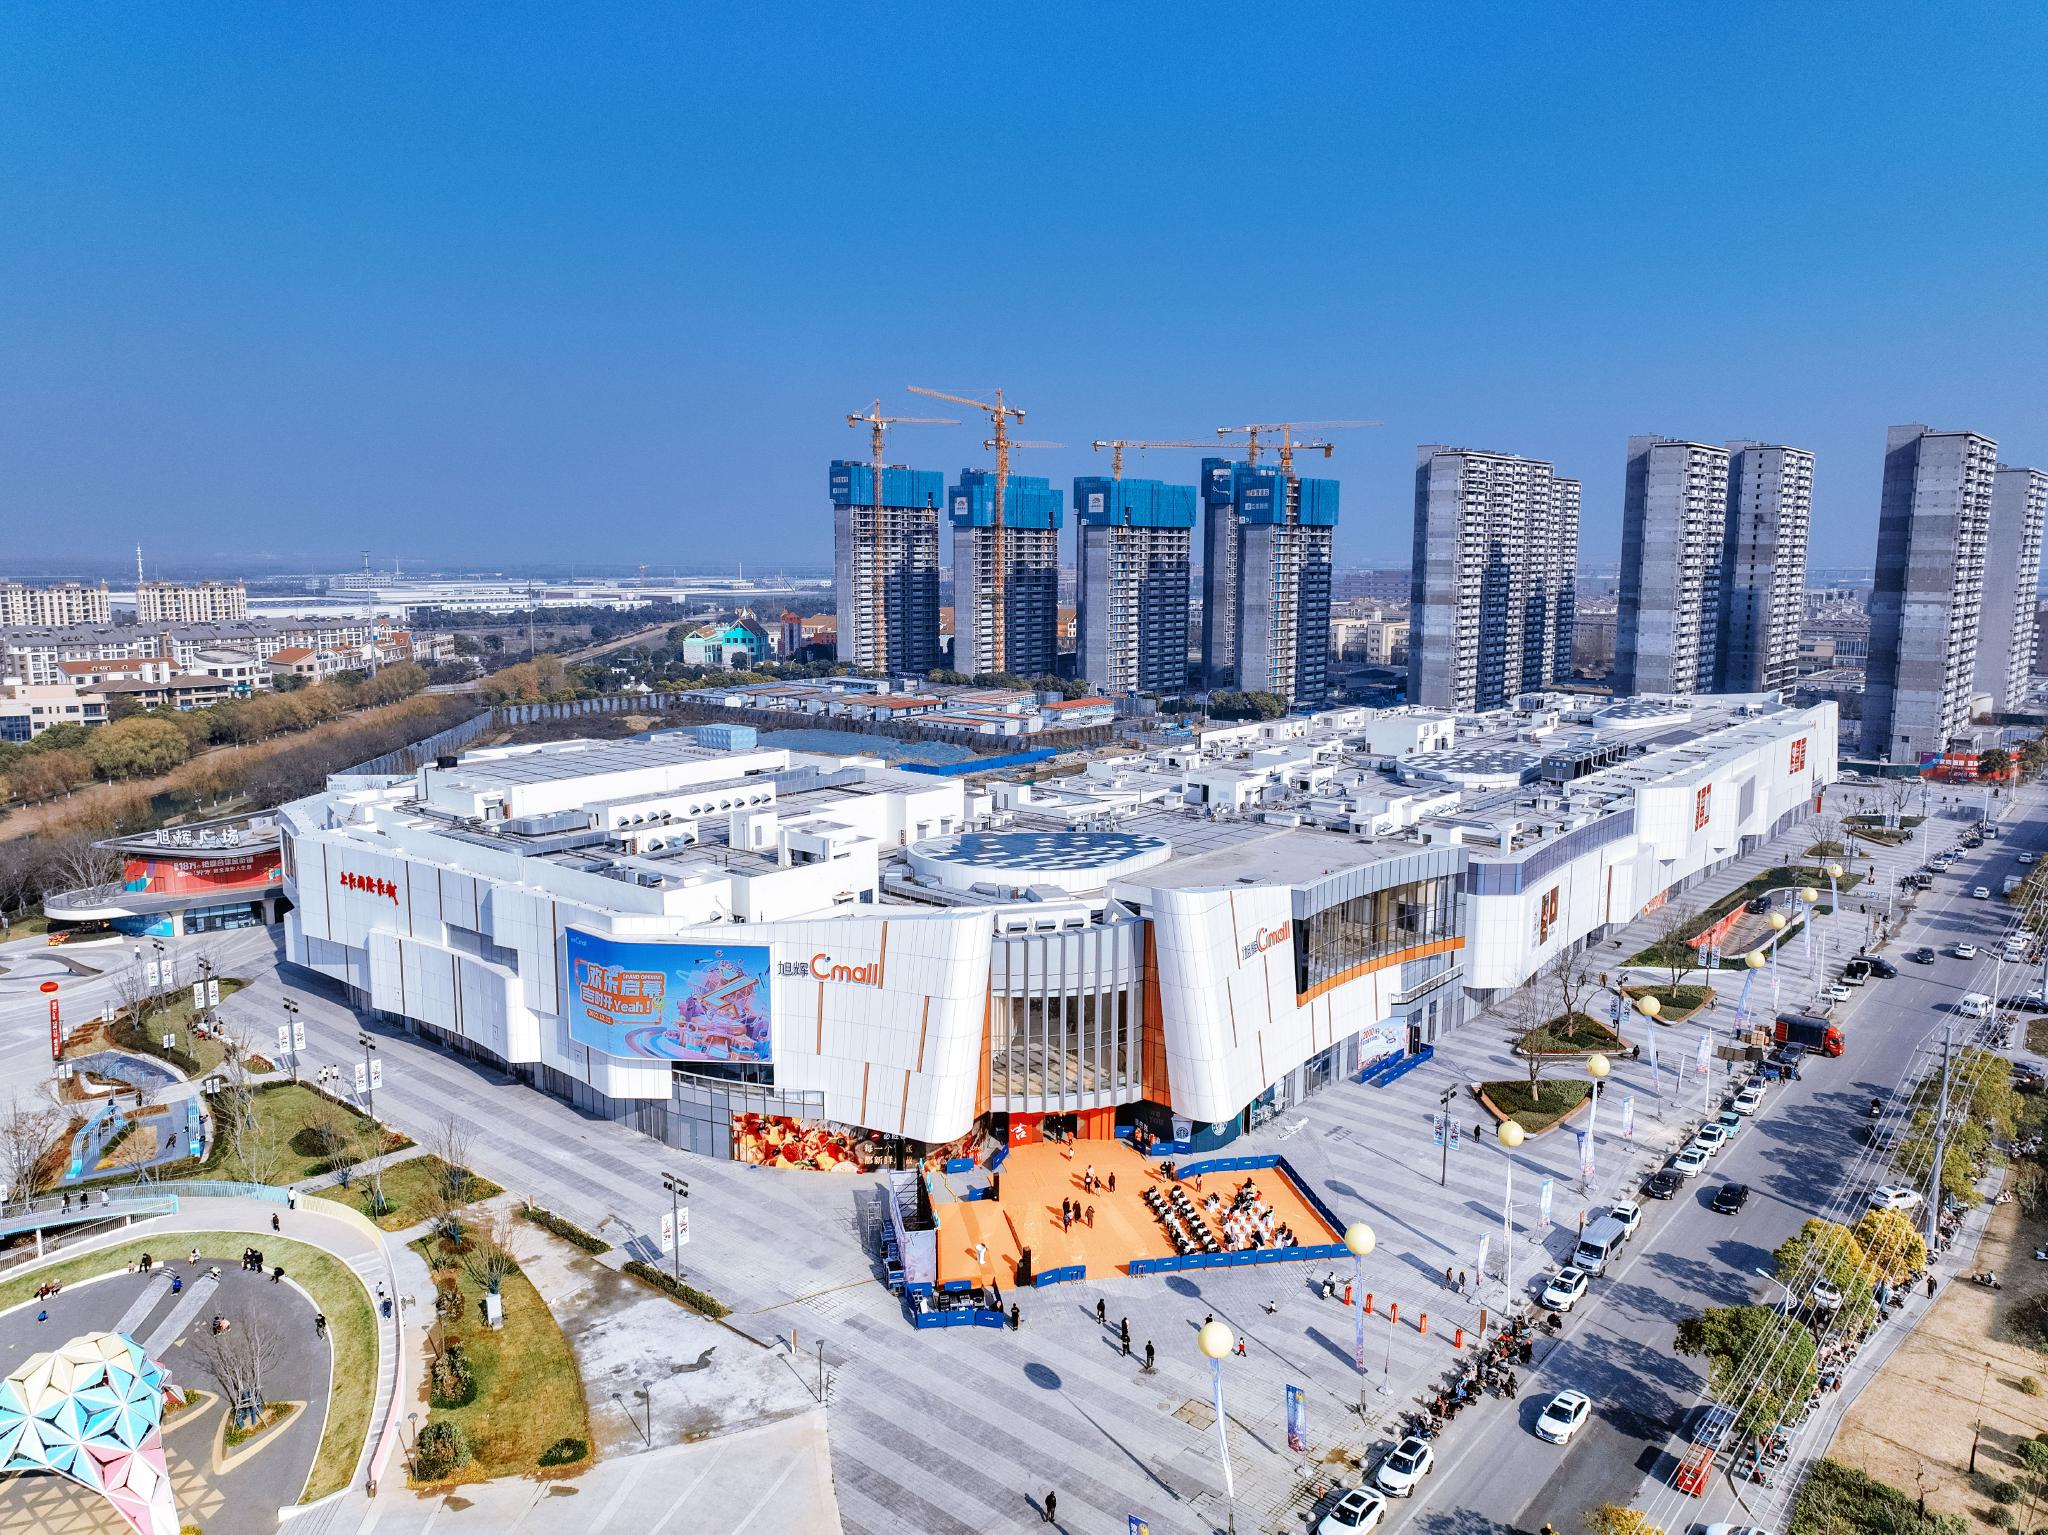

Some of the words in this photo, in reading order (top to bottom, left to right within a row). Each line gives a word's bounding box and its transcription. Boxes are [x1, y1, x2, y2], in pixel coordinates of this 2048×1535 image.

[155, 827, 240, 846] 旭辉广场
[1256, 920, 1290, 952] Cmall
[589, 966, 662, 998] 欢乐启幕
[777, 960, 809, 978] 旭辉
[810, 953, 879, 985] Cmall
